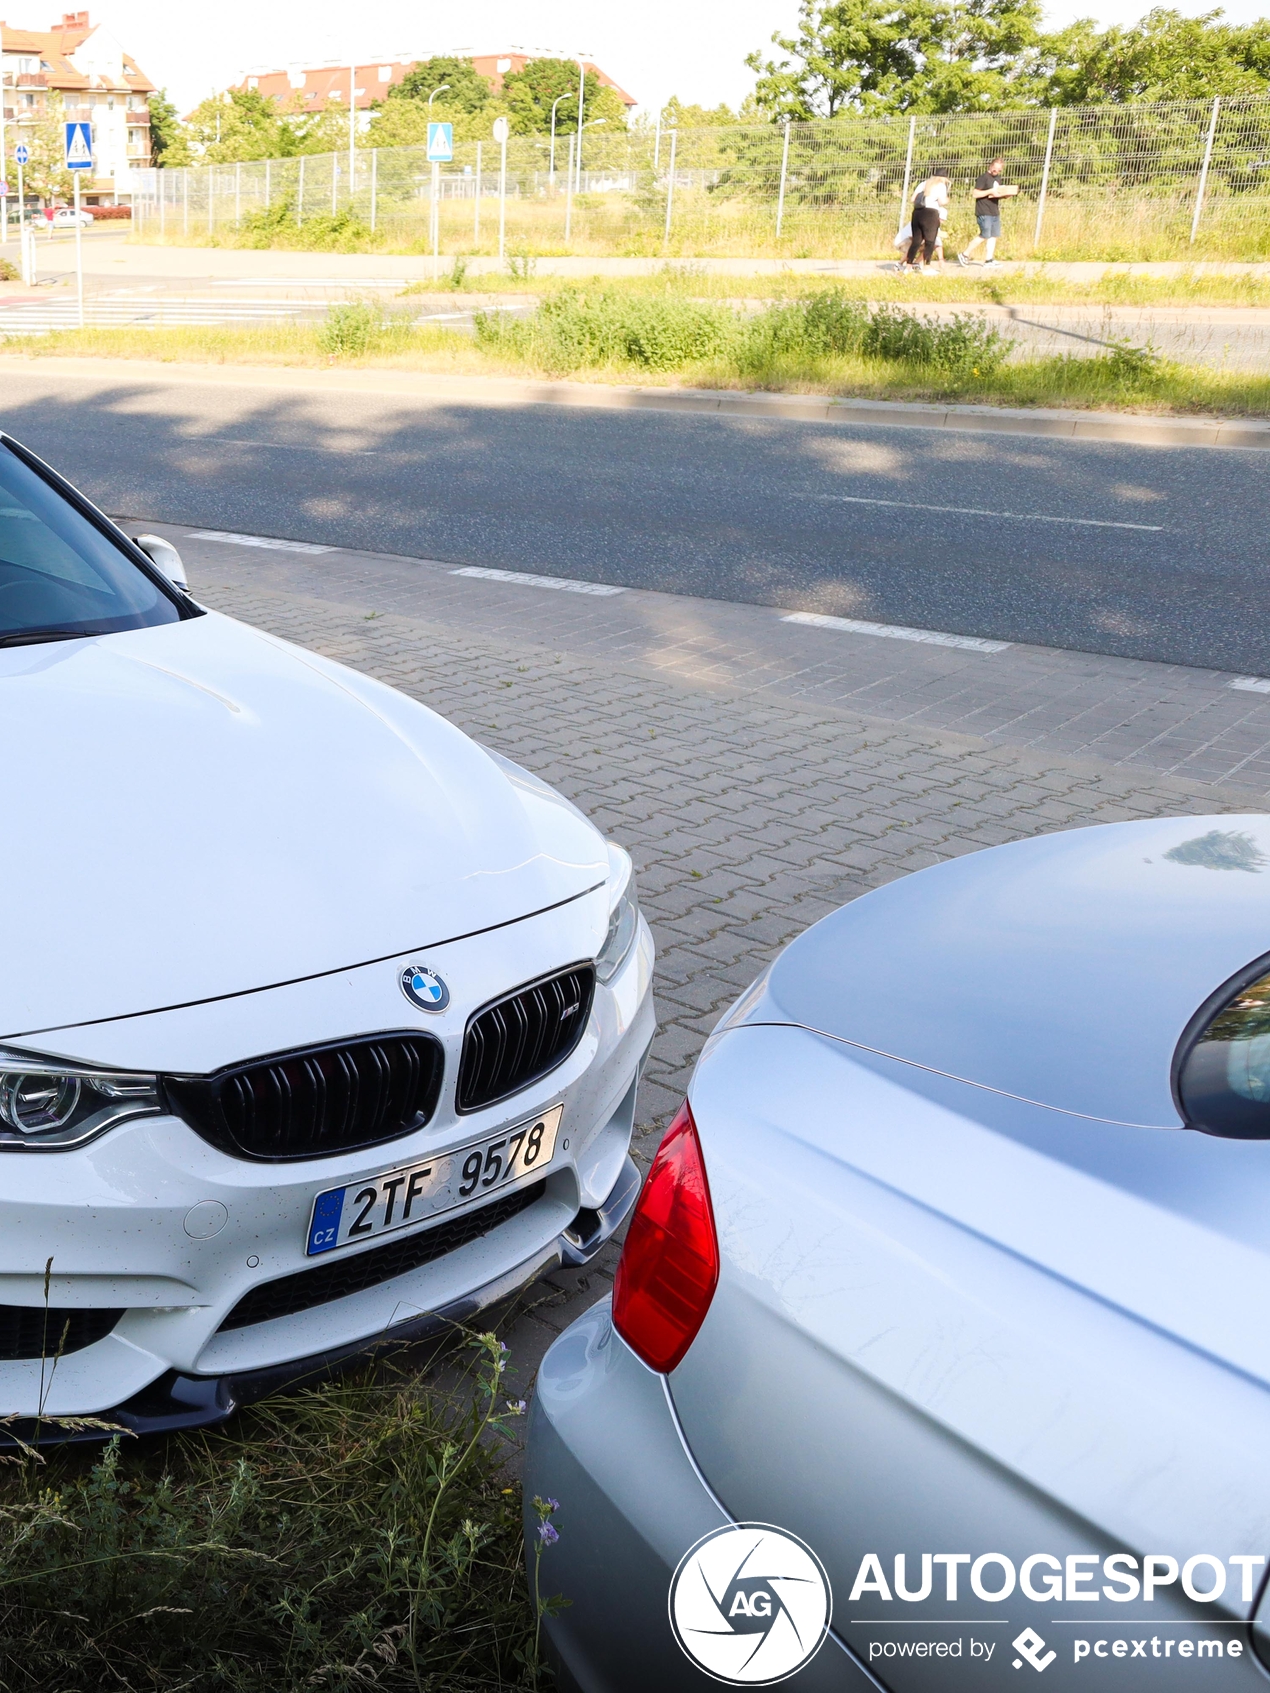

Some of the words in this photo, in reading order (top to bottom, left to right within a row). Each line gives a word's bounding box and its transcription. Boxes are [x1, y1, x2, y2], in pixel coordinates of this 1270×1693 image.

[403, 966, 437, 984] BMW
[348, 1167, 432, 1237] 2TF
[458, 1121, 545, 1197] 9578
[314, 1227, 335, 1245] CZ
